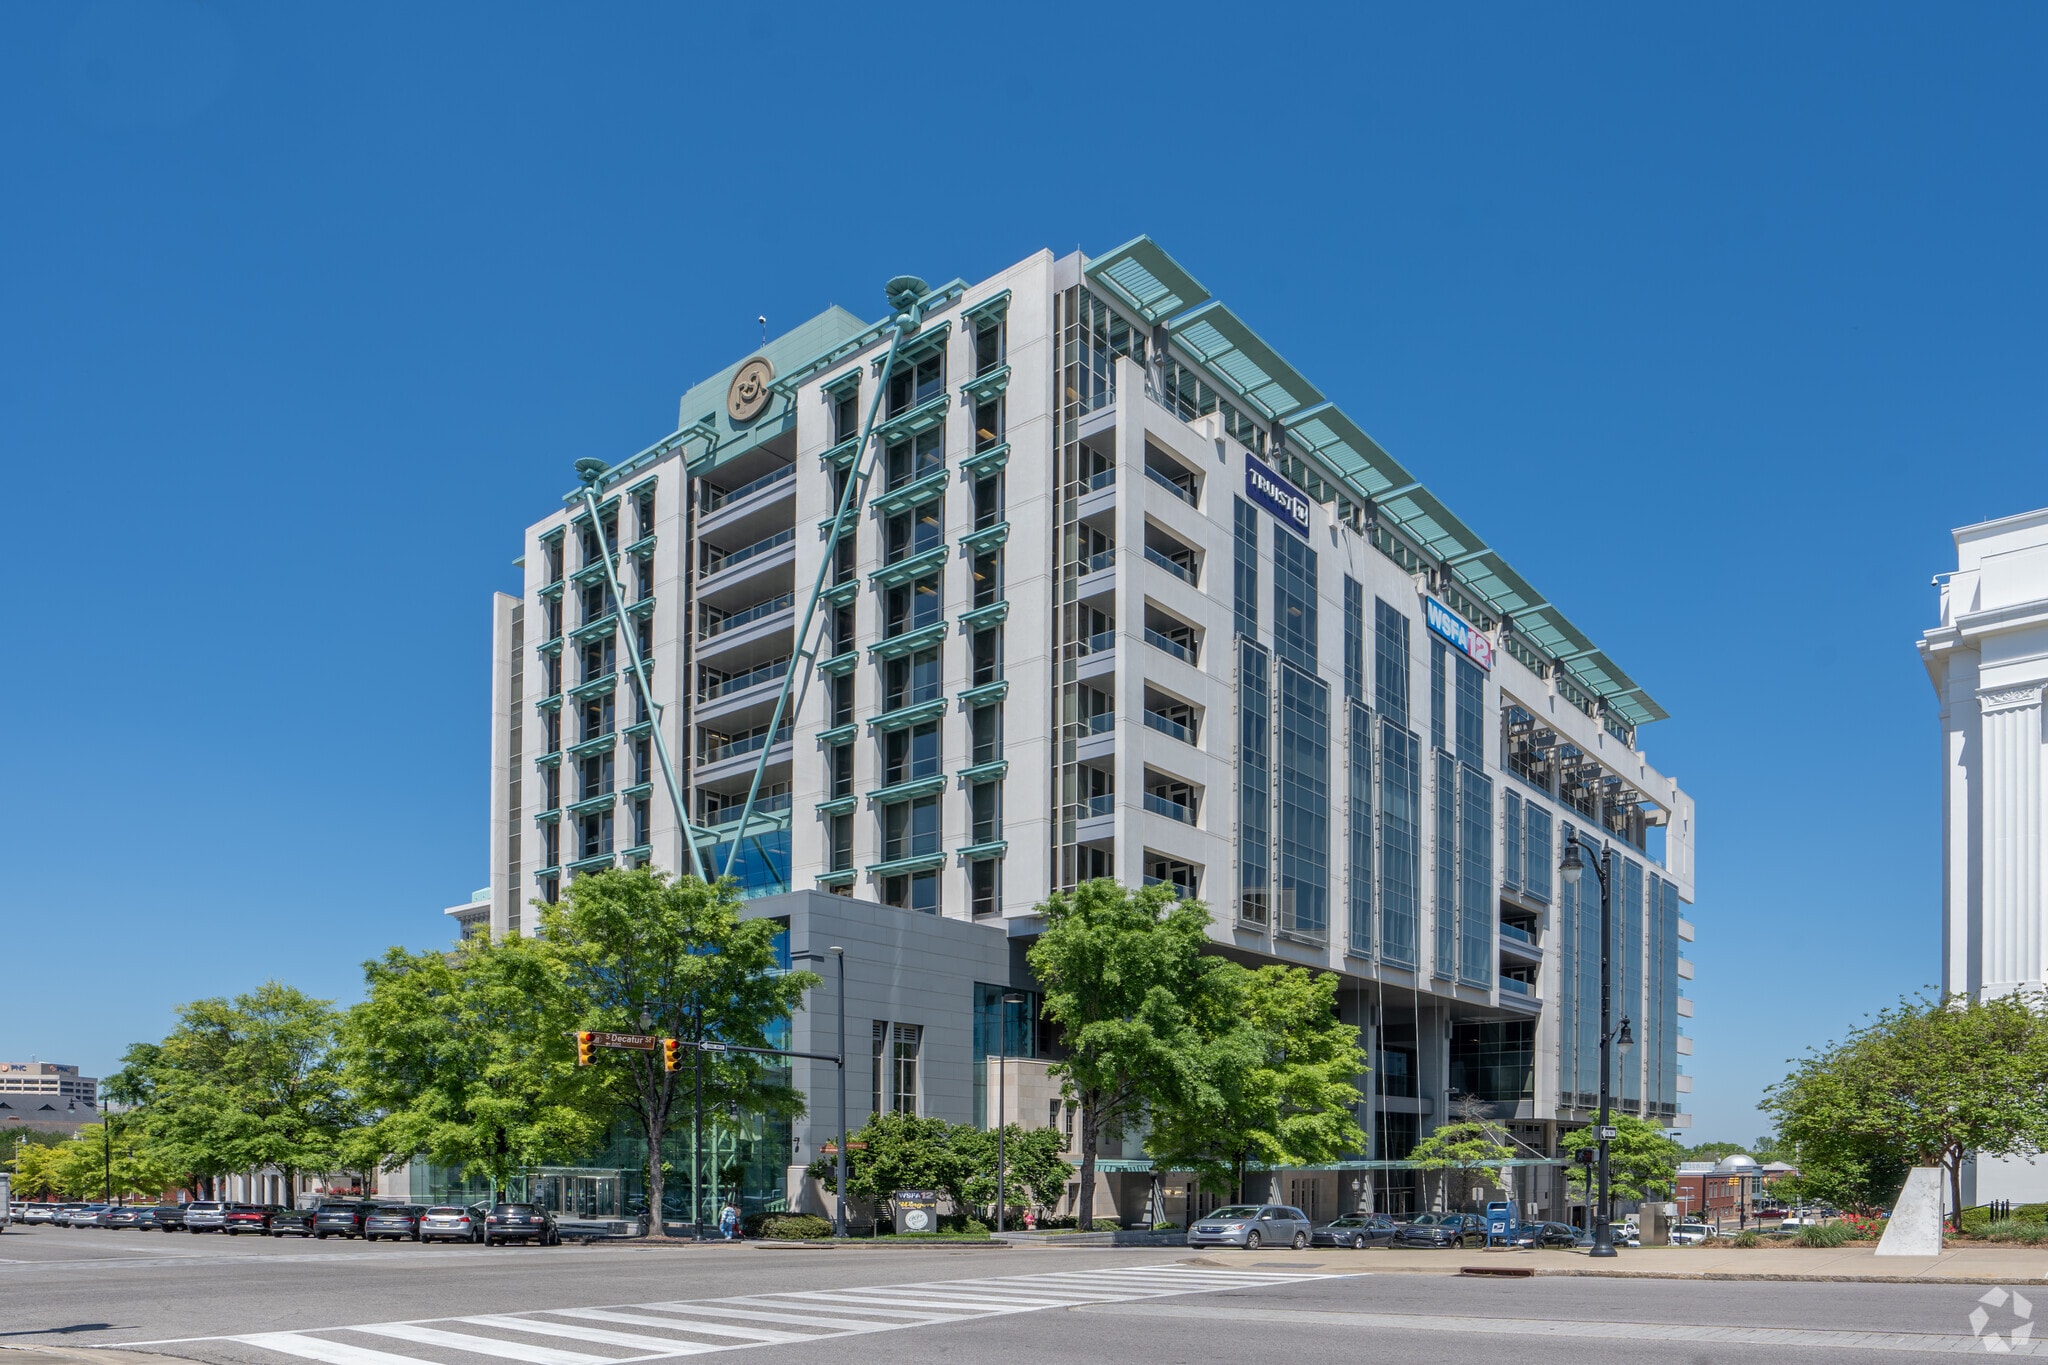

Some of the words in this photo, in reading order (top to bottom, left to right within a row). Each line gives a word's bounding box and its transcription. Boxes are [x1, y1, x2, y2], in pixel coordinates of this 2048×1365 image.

[1249, 468, 1293, 510] TRUIST
[1427, 600, 1468, 652] WSFA
[1468, 630, 1490, 665] 12
[611, 1034, 643, 1044] Decatur
[11, 1064, 27, 1072] PNC
[920, 1191, 934, 1200] 12
